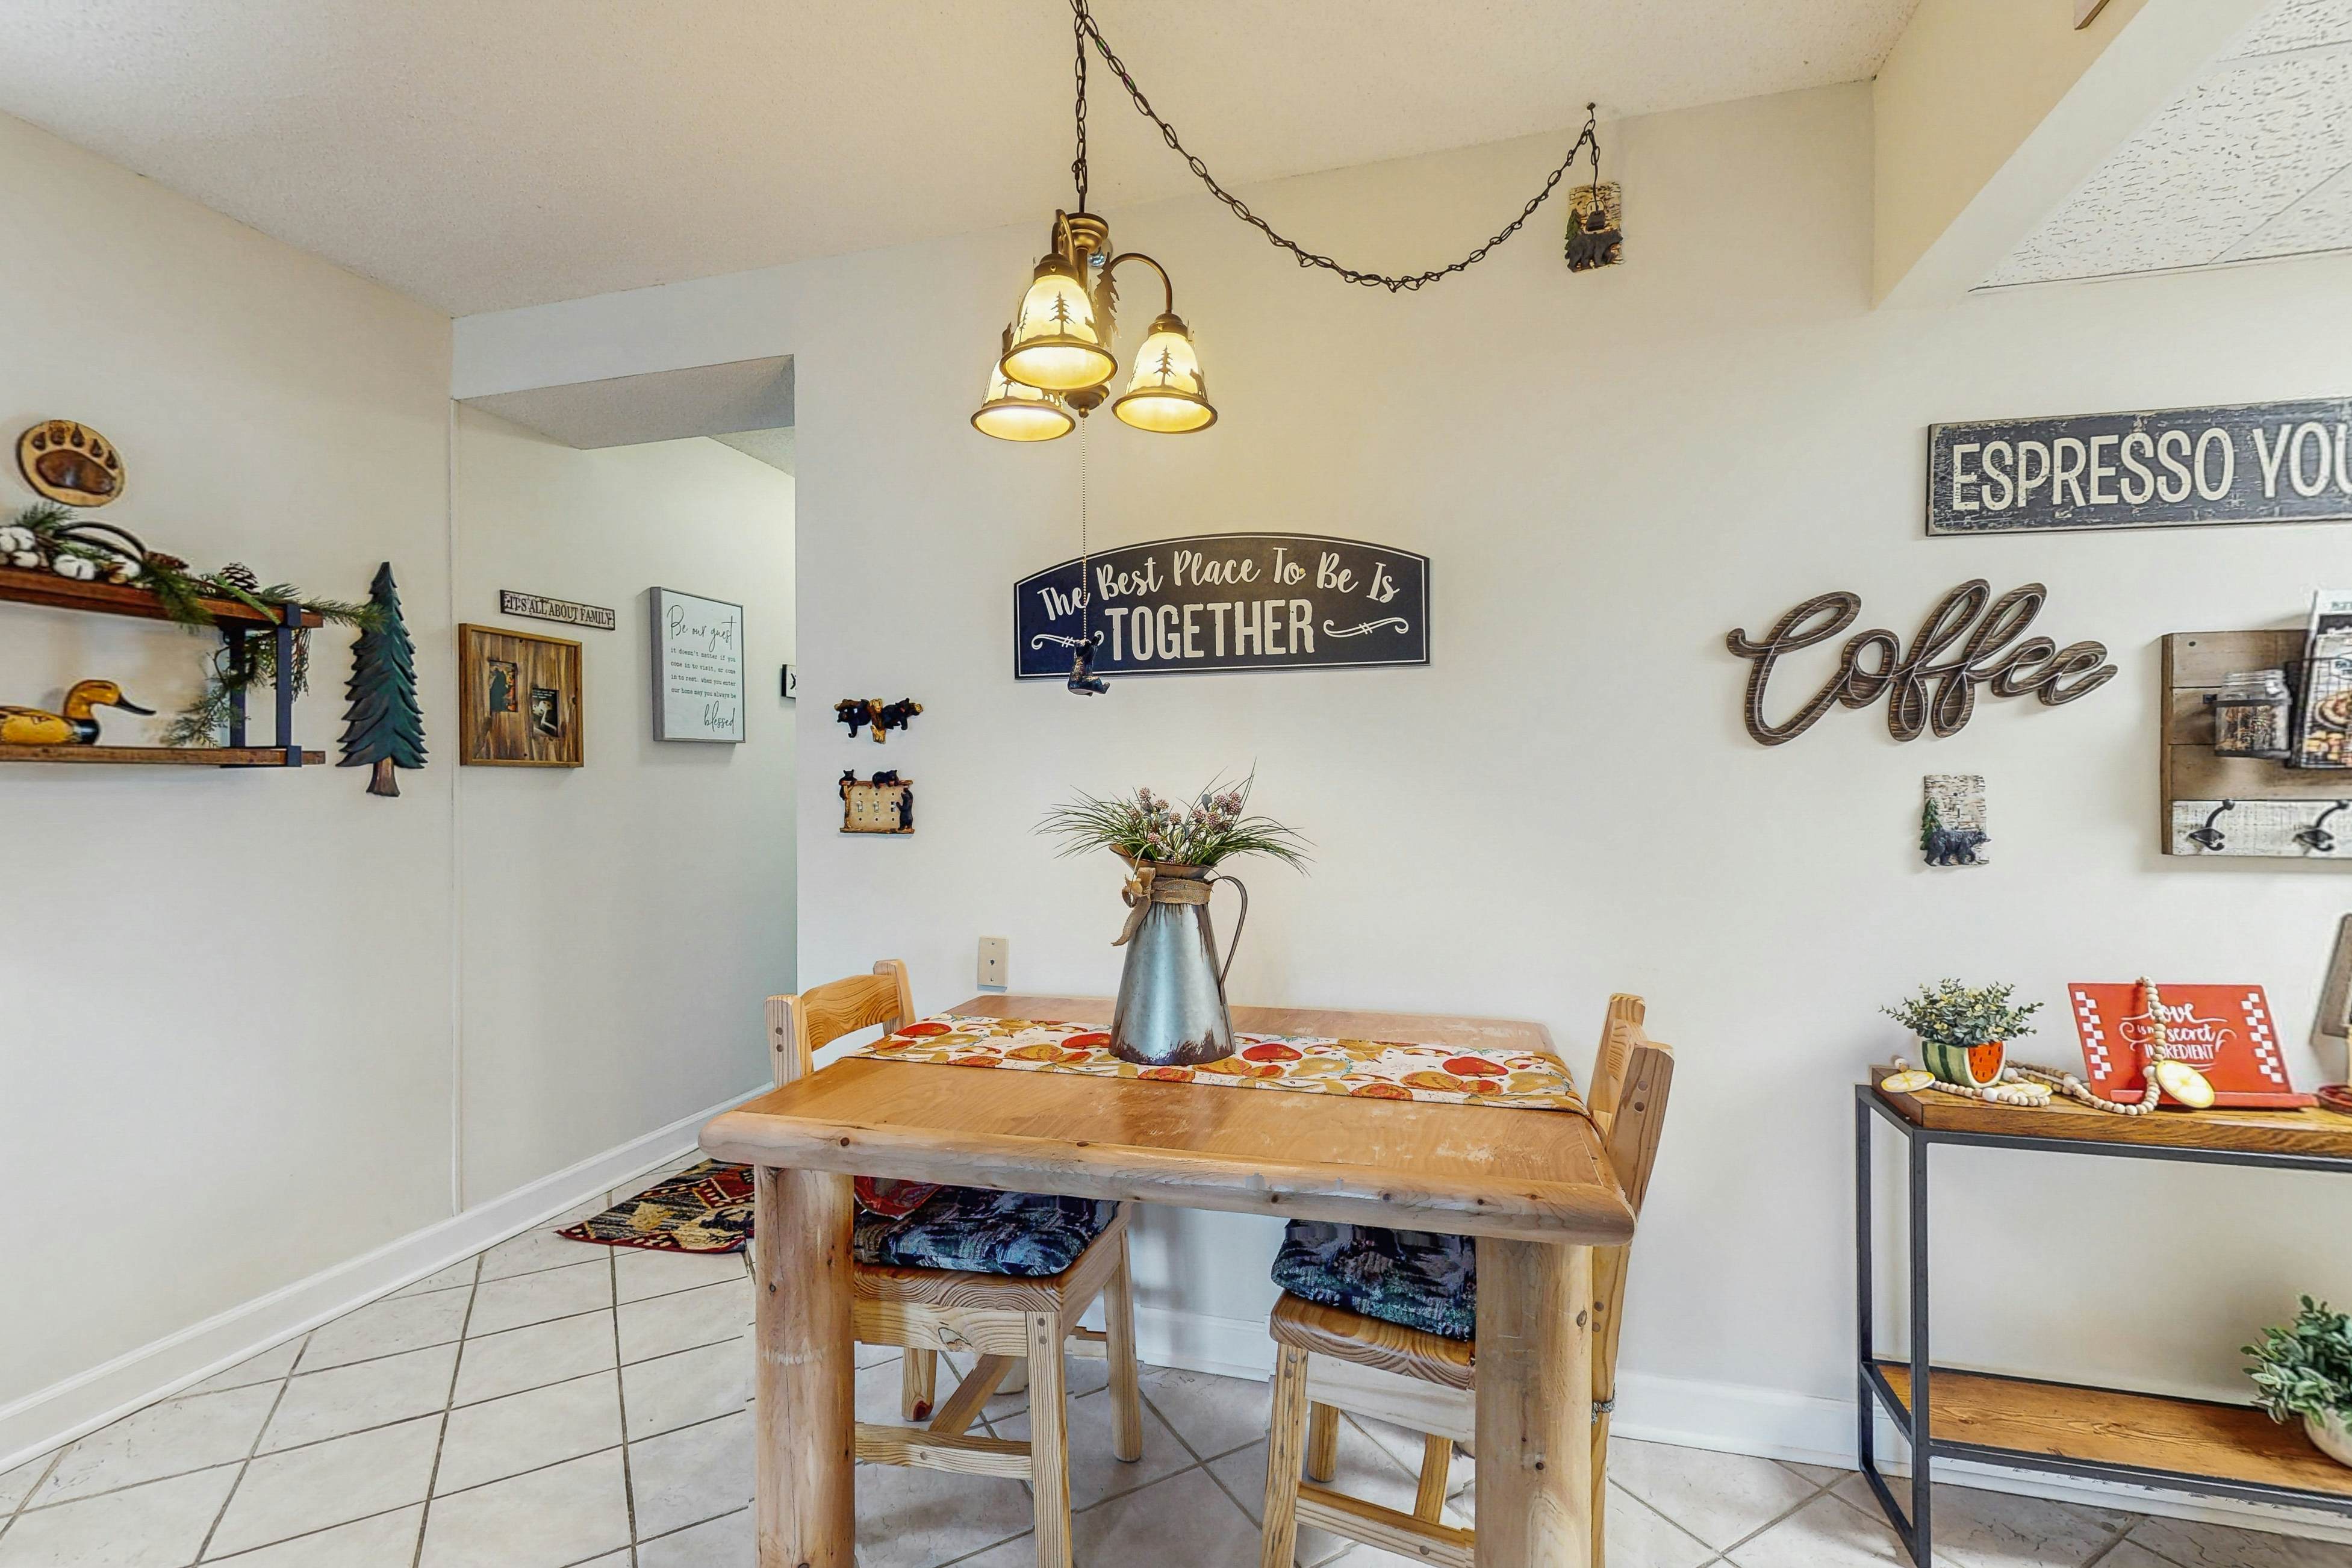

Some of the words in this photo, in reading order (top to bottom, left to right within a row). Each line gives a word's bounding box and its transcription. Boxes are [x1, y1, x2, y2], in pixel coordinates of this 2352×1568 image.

[1952, 427, 2235, 511] ESPRESSO
[1038, 587, 1090, 621] The
[1096, 556, 1165, 601] Best
[1173, 549, 1262, 587] Place
[1272, 547, 1305, 585] To
[1316, 552, 1359, 593] Be
[1366, 561, 1401, 603] Is
[529, 600, 547, 615] ALL
[549, 603, 579, 621] ABOUT
[580, 608, 612, 625] FAMILY
[667, 605, 688, 639] Be
[709, 615, 737, 653] guest
[1104, 599, 1315, 661] TOGETHER
[679, 648, 698, 656] doesn't
[1726, 578, 2118, 746] Coffee
[704, 700, 735, 735] blessed
[2144, 1044, 2214, 1060] INREDIENT
[2167, 1024, 2217, 1041] secret
